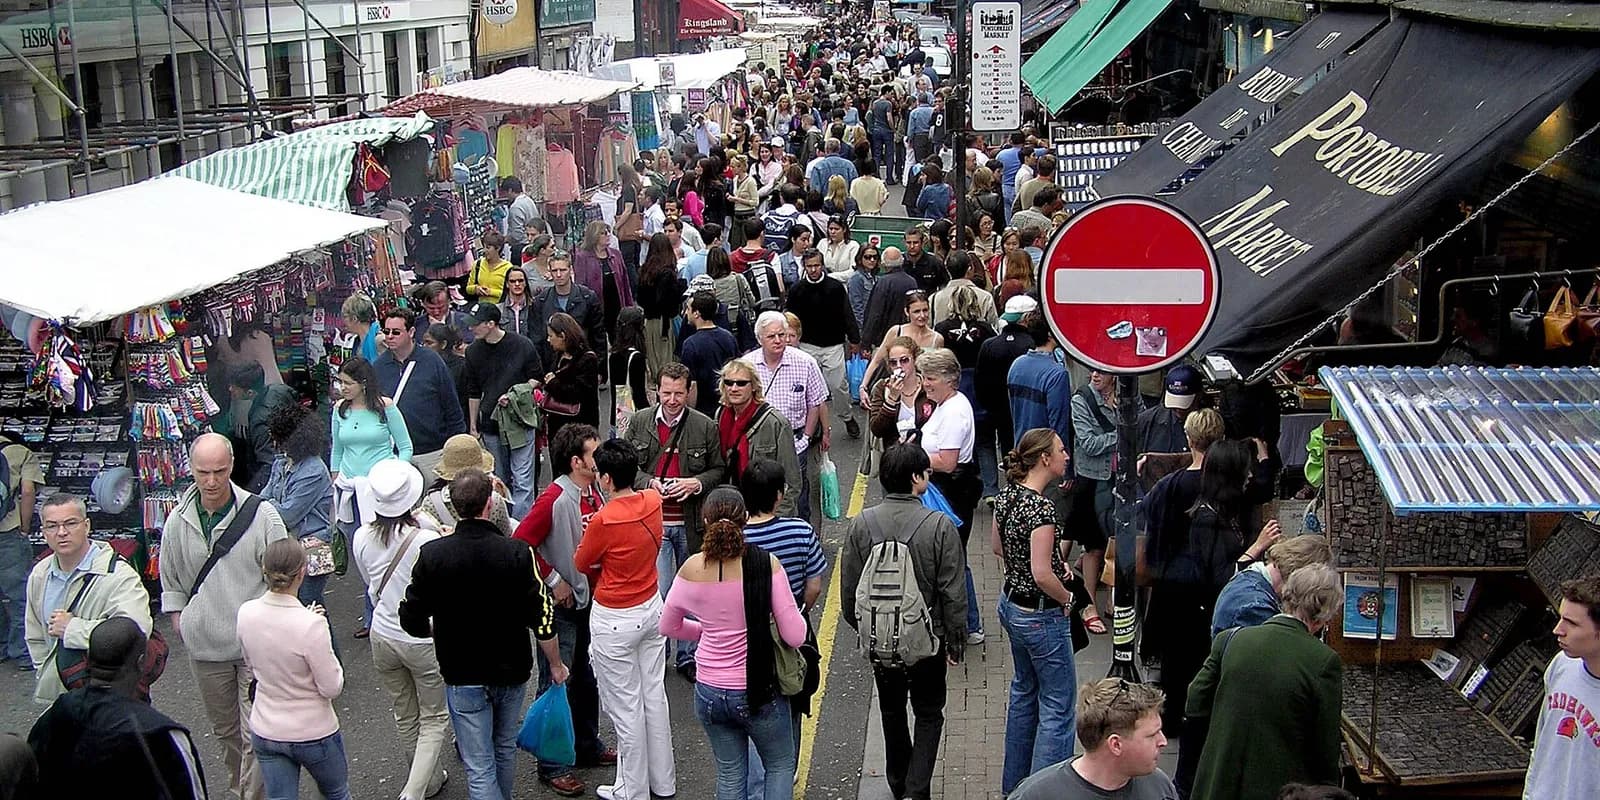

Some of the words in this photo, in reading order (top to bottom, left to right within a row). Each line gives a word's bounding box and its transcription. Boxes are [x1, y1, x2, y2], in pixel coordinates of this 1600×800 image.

[486, 5, 514, 15] HSBC
[683, 18, 728, 27] Kingsland
[936, 113, 944, 127] 8
[1199, 184, 1314, 277] MARKET
